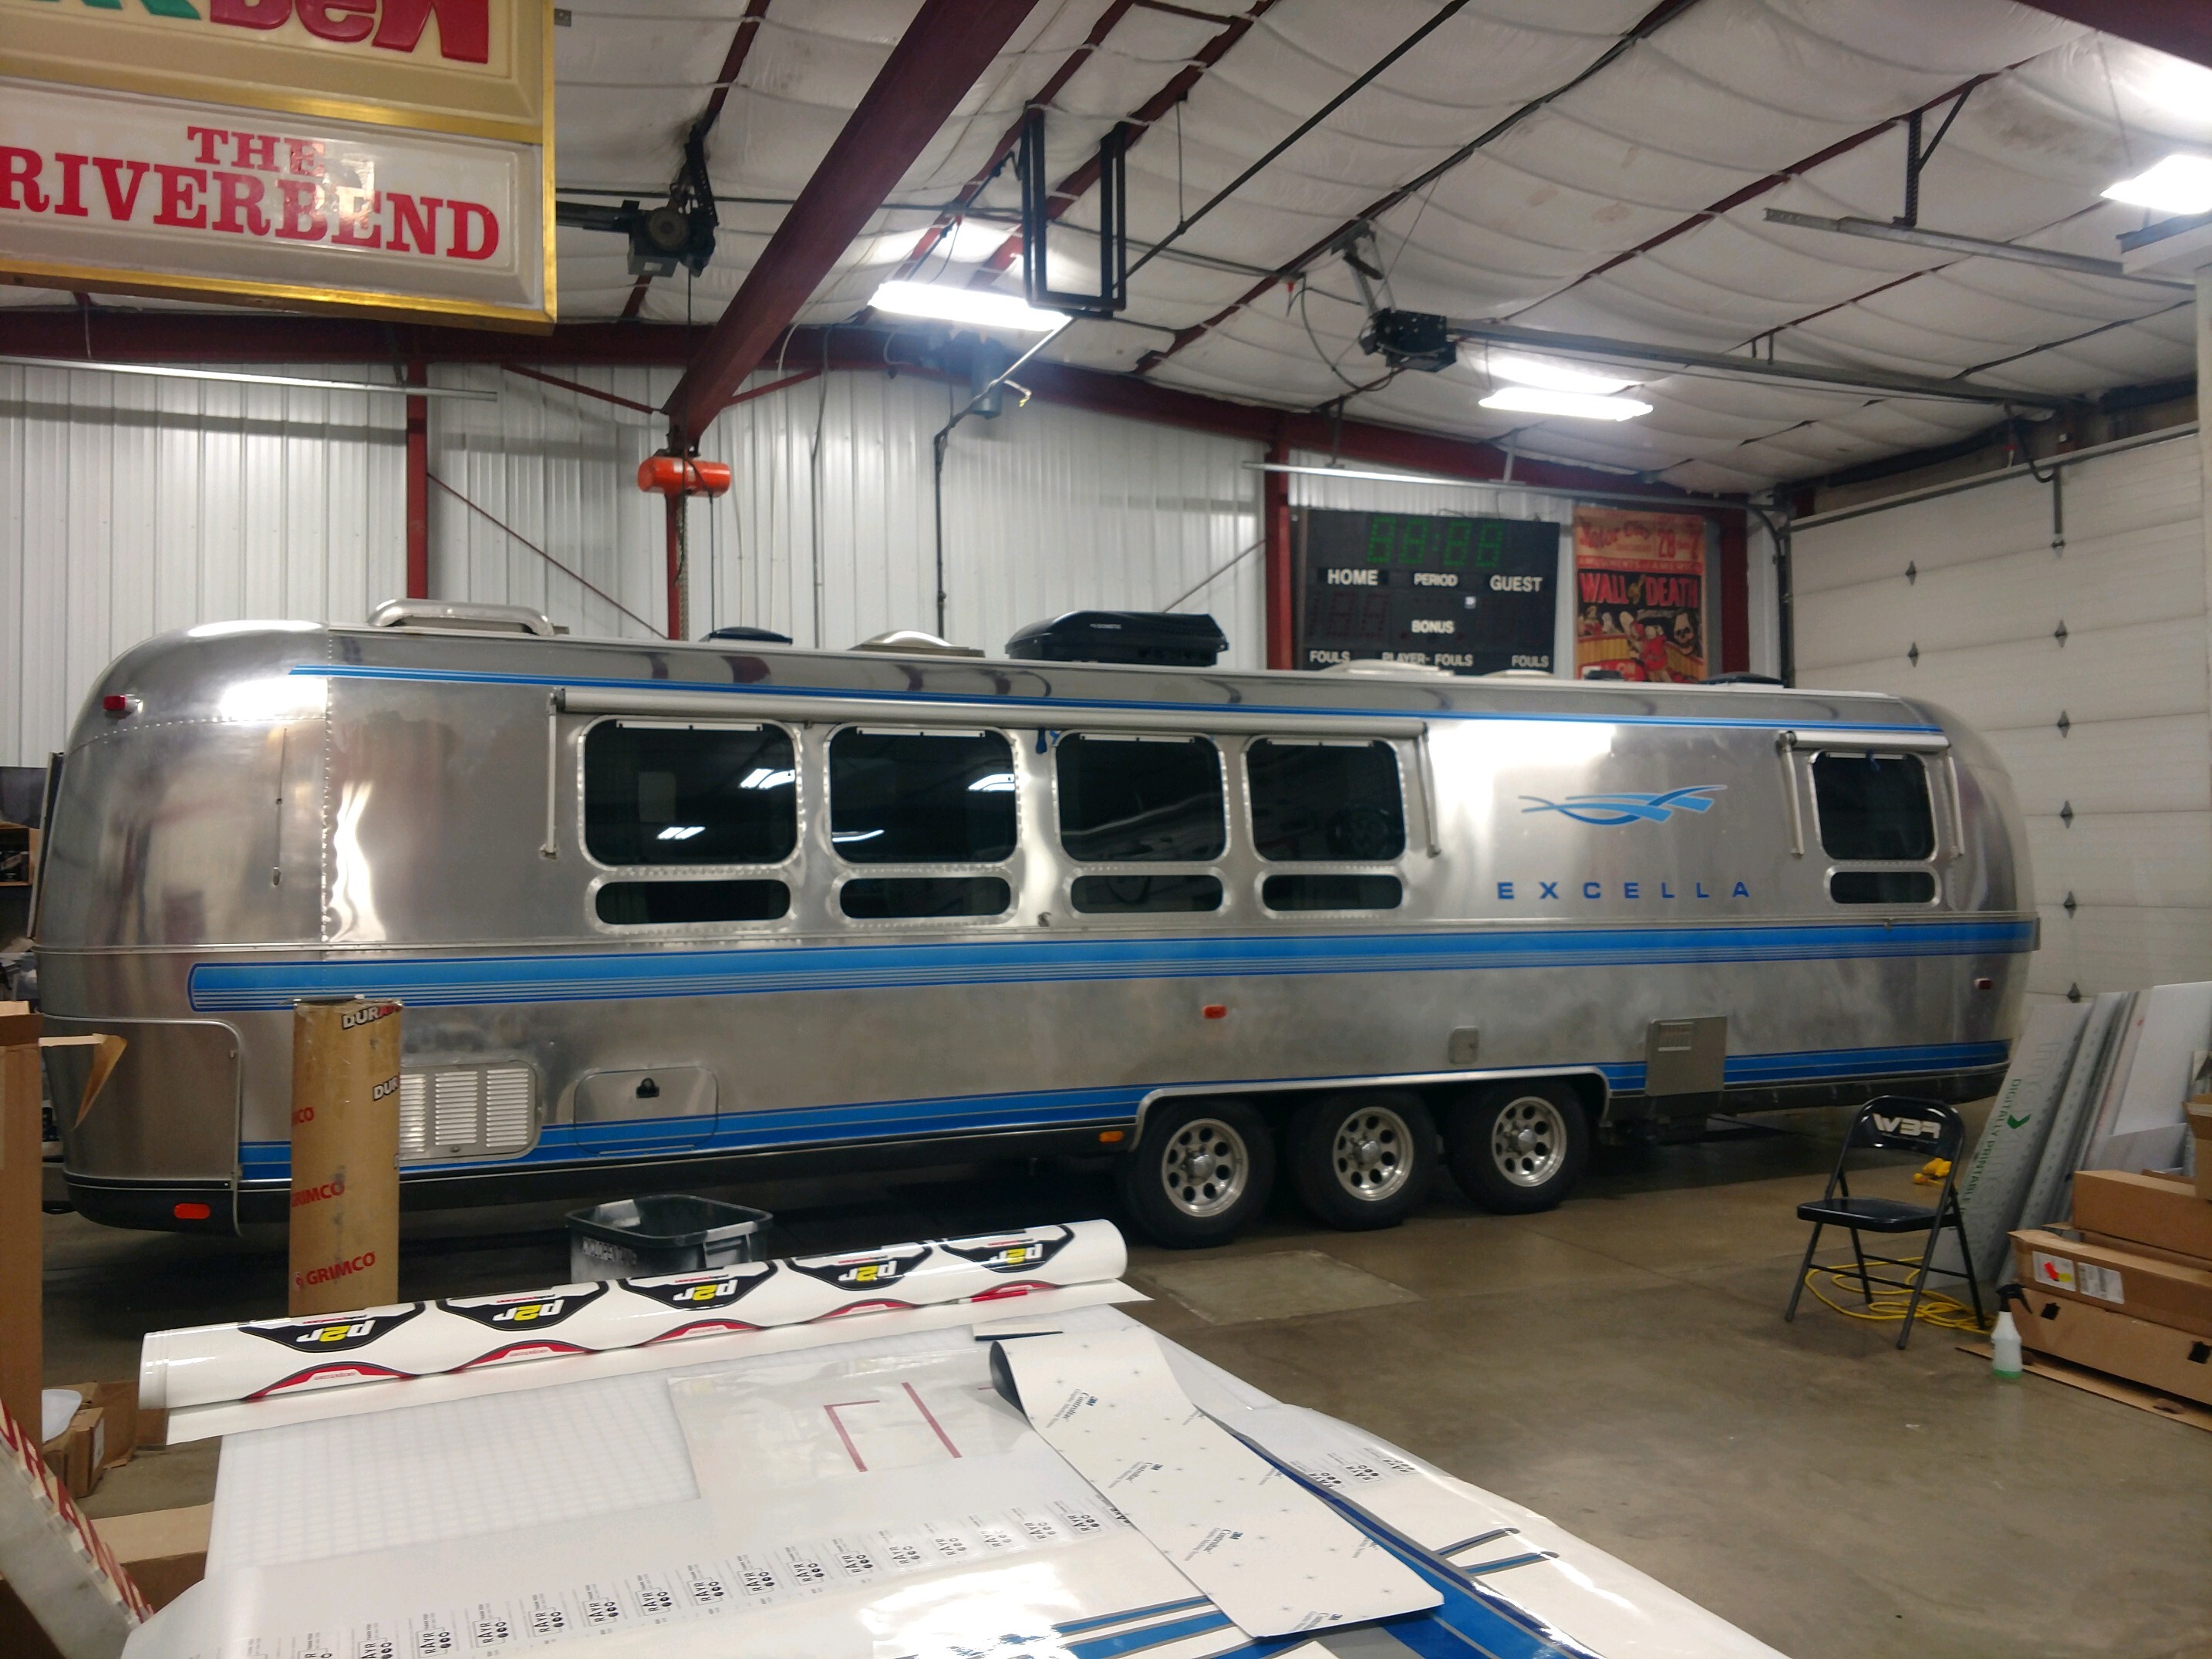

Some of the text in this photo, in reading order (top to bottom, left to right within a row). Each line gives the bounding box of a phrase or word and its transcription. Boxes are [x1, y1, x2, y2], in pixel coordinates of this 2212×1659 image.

[187, 126, 325, 177] THE
[0, 145, 500, 261] RIVERBEND
[1327, 569, 1378, 585] HOME
[1414, 572, 1458, 586] PERIOD
[1490, 575, 1543, 592] GUEST
[1580, 573, 1629, 604] WALL
[1645, 577, 1697, 608] DEATH
[1411, 619, 1455, 634] BONUS
[1310, 650, 1350, 663] FOULS
[1435, 654, 1473, 667] FOULS
[1512, 656, 1549, 668] FOULS
[1497, 881, 1749, 900] EXCELLA
[1962, 1079, 2021, 1201] DIGITALLY PRINTABLE
[306, 1252, 375, 1285] GRIMCO
[794, 1563, 812, 1583] RAYR
[842, 1555, 862, 1573] RAYR
[694, 1582, 710, 1602] RAYR
[744, 1573, 762, 1592] RAYR
[643, 1592, 658, 1612] RAYR
[534, 1612, 549, 1633] RAYR
[589, 1602, 605, 1623] RAYR
[420, 1632, 435, 1654] RAYR
[478, 1622, 493, 1644] RAYR
